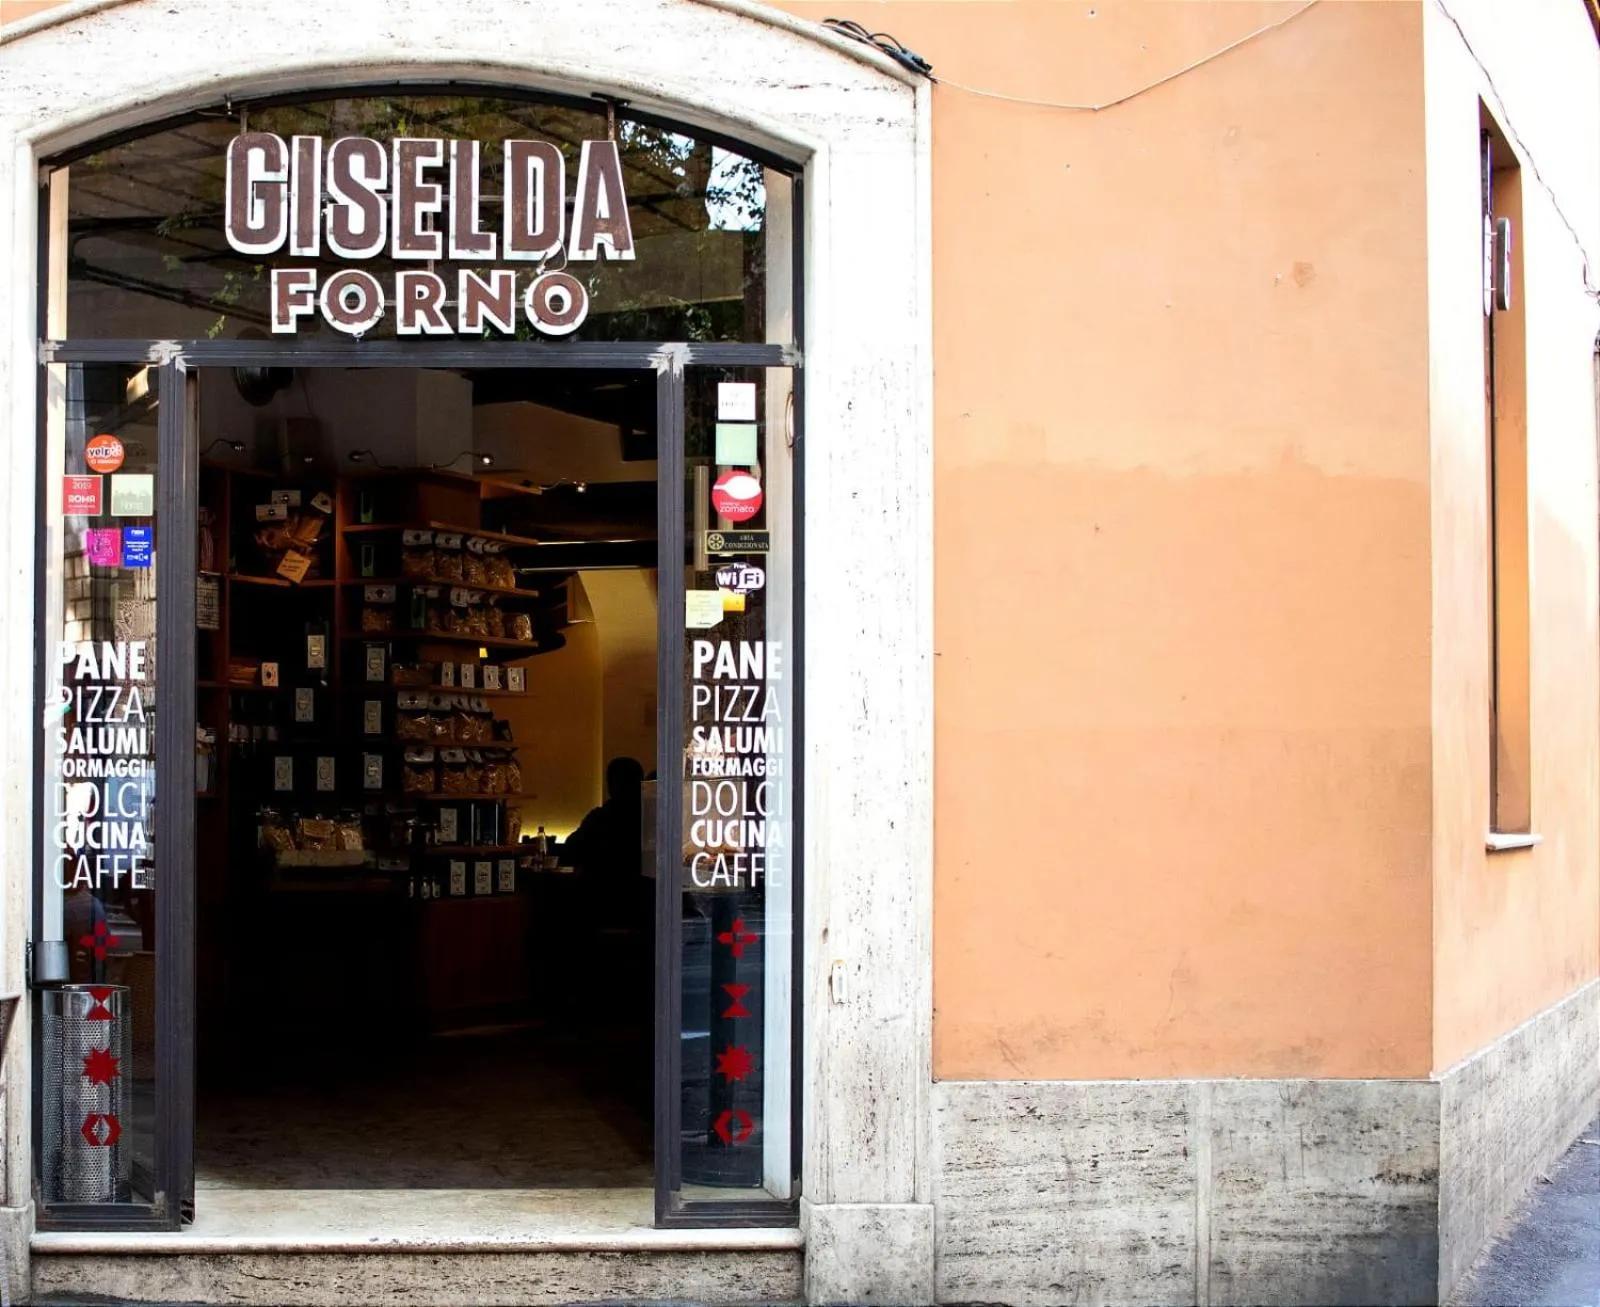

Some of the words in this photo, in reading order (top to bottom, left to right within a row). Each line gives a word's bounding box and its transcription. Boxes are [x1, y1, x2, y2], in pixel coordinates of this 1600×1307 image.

[225, 132, 635, 261] GISELDA
[271, 268, 589, 336] FORNO
[720, 505, 755, 513] zomato
[56, 641, 146, 680] PANE
[692, 640, 783, 679] PANE
[56, 686, 145, 723] PIZZA
[692, 685, 782, 722] PIZZA
[55, 727, 146, 754] SALUMI
[692, 726, 784, 753] SALUMI
[55, 758, 146, 778] FORMAGGI
[692, 757, 783, 777] FORMAGGI
[54, 782, 146, 818] DOLCI
[691, 780, 783, 816] DOLCI
[53, 821, 146, 849] CUCINA
[690, 820, 784, 848] CUCINA
